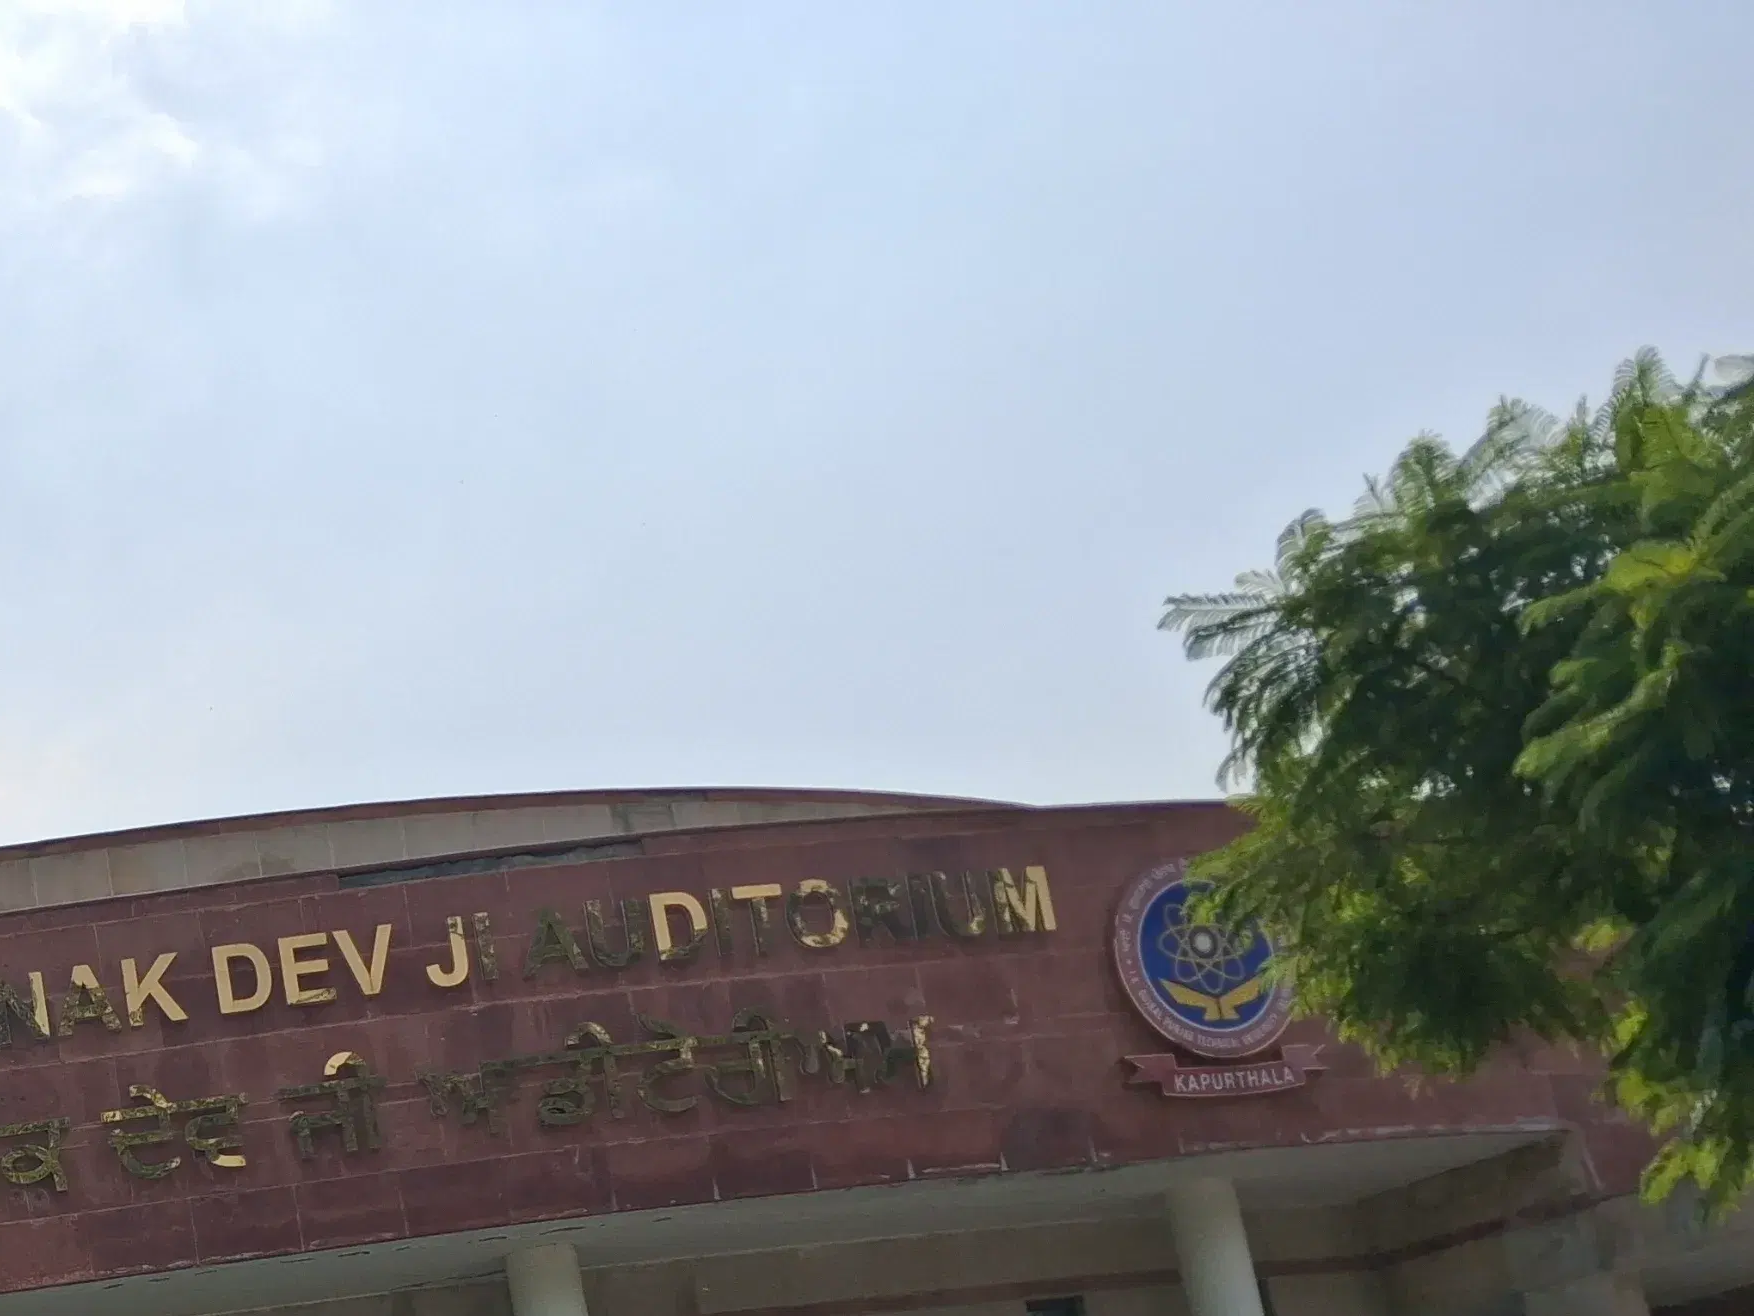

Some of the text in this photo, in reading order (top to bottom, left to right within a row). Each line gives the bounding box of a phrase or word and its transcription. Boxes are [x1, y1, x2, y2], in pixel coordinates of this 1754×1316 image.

[211, 923, 392, 1016] DEV
[427, 910, 500, 988] JI
[525, 865, 1059, 982] AUDITORIUM
[100, 1083, 248, 1180] ਦੇਵ
[279, 1050, 386, 1160] ਜੀ
[1173, 1066, 1296, 1094] KAPURTHALA
